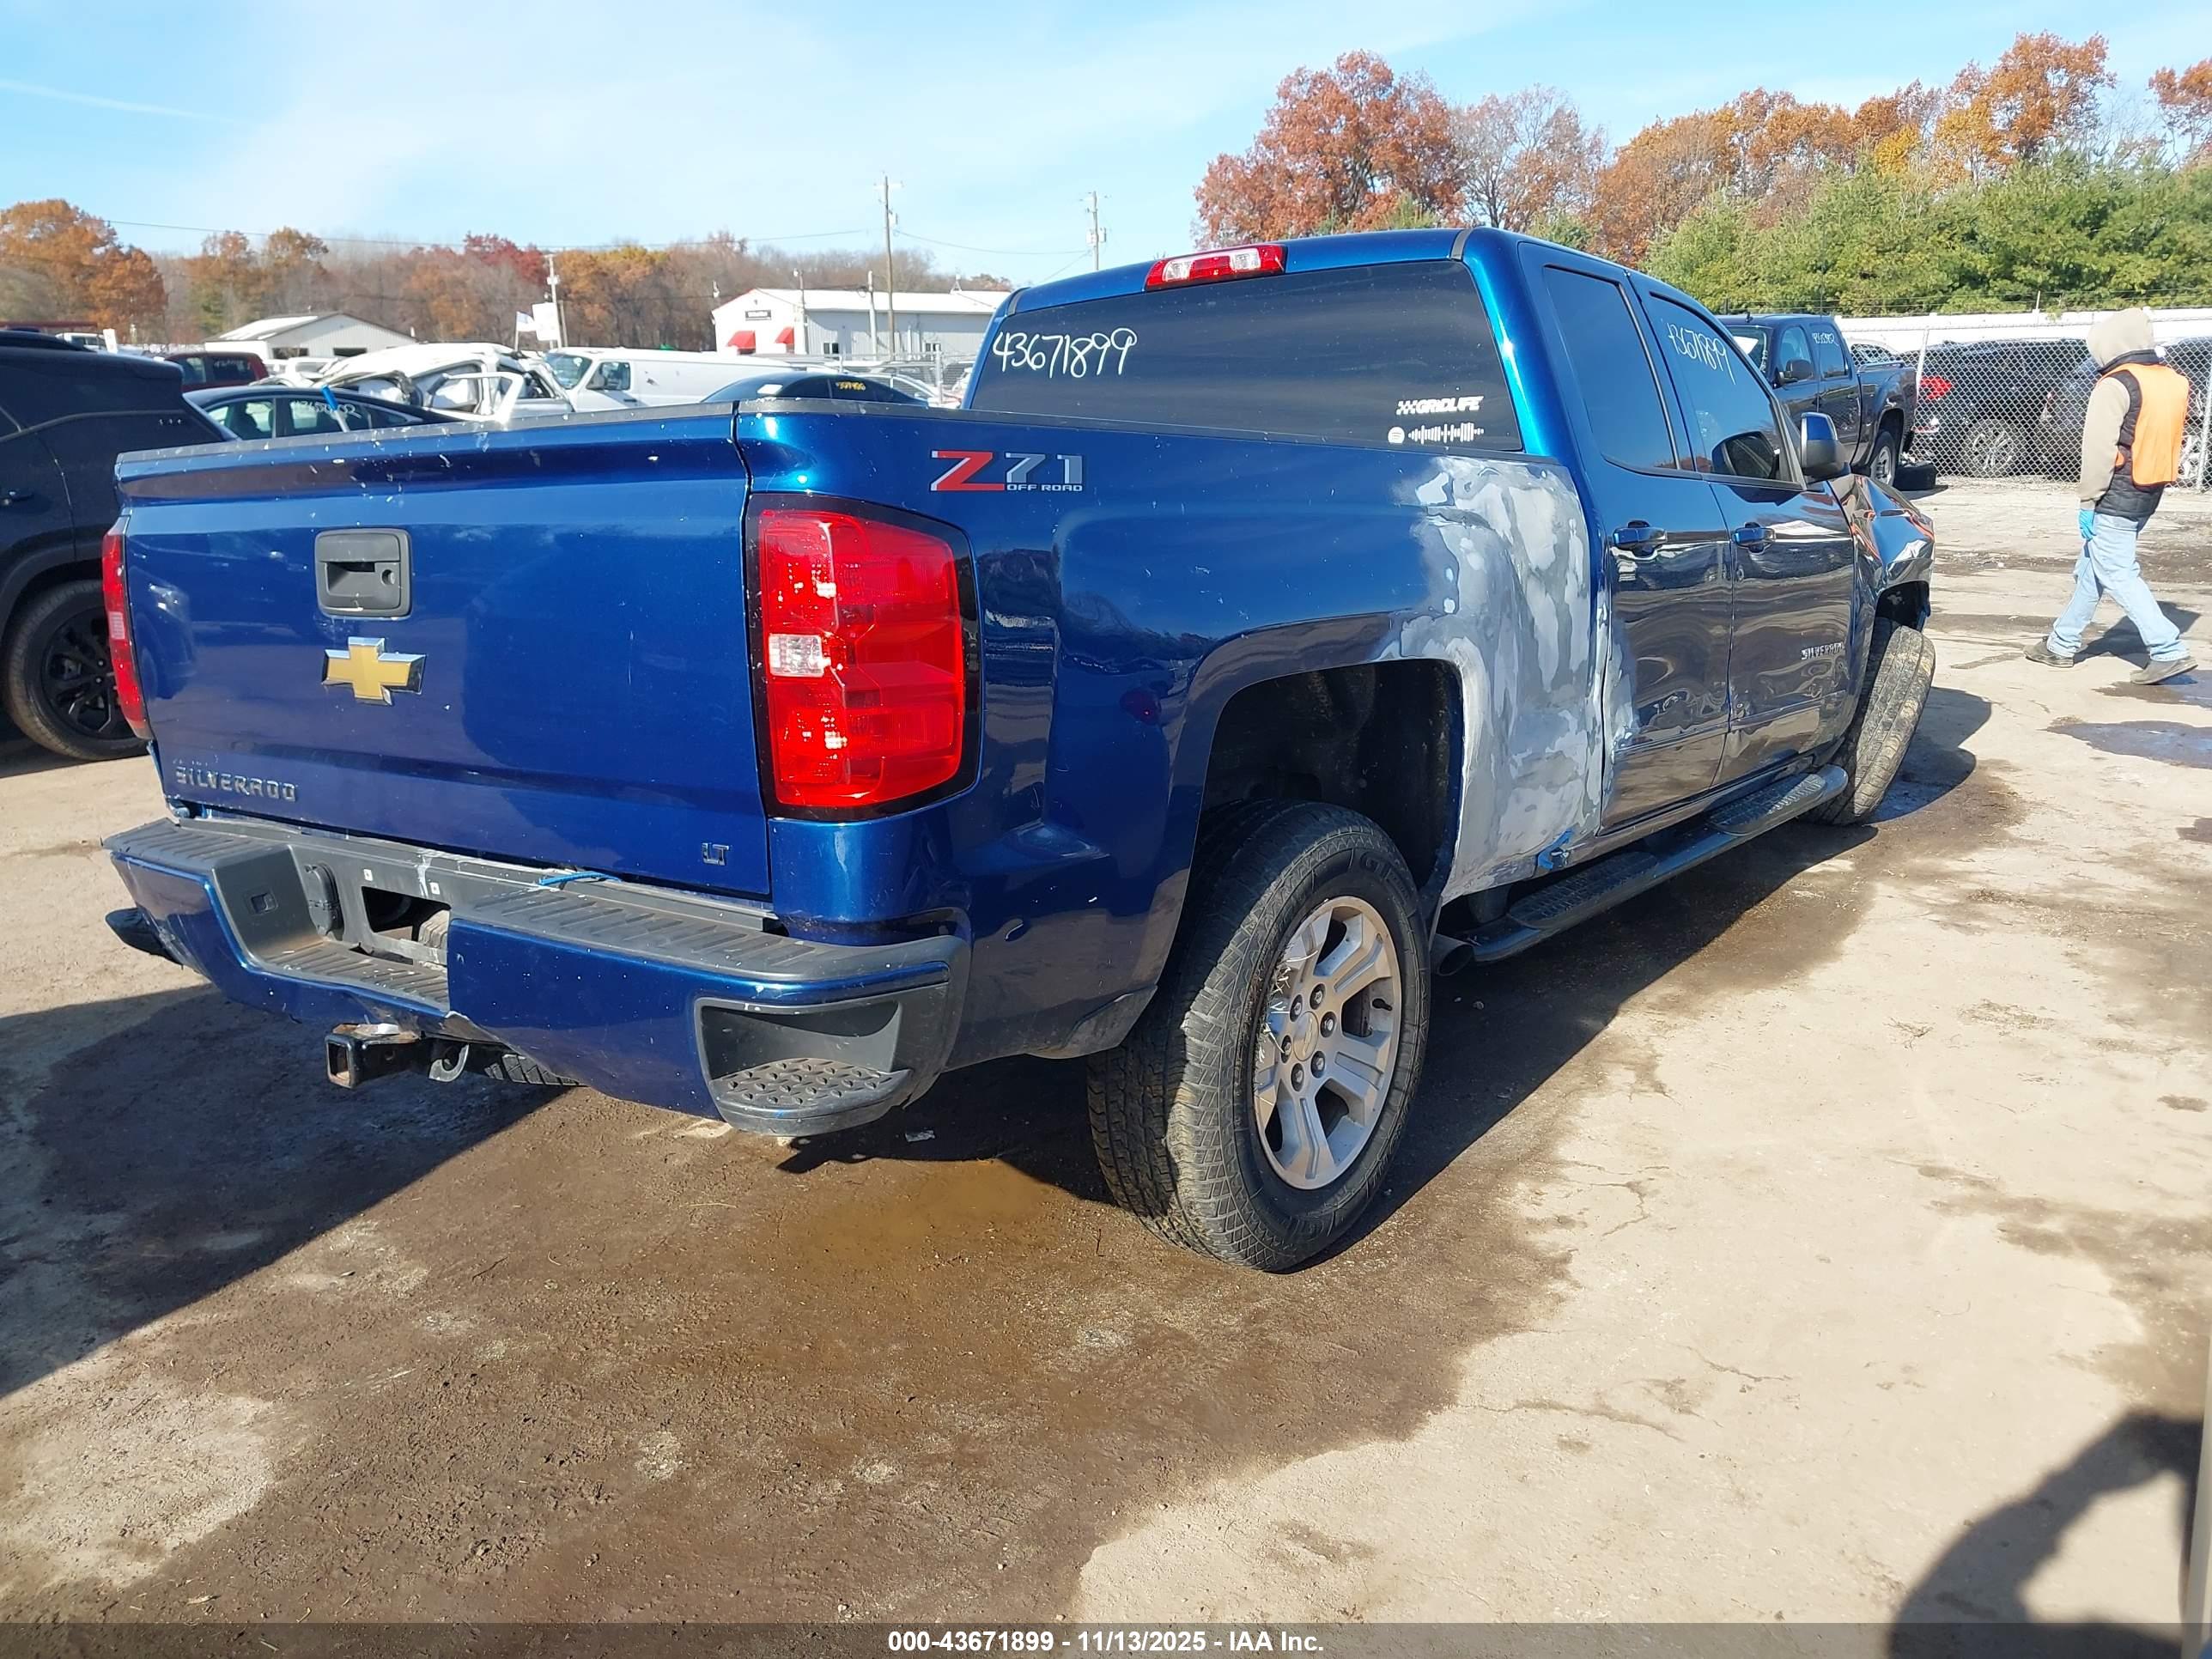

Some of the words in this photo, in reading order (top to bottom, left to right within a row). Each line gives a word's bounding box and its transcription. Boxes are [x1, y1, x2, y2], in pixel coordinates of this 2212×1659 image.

[993, 327, 1138, 379] 43671899
[930, 450, 1083, 491] Z71
[176, 766, 296, 802] SILVERADO
[702, 842, 729, 866] LT
